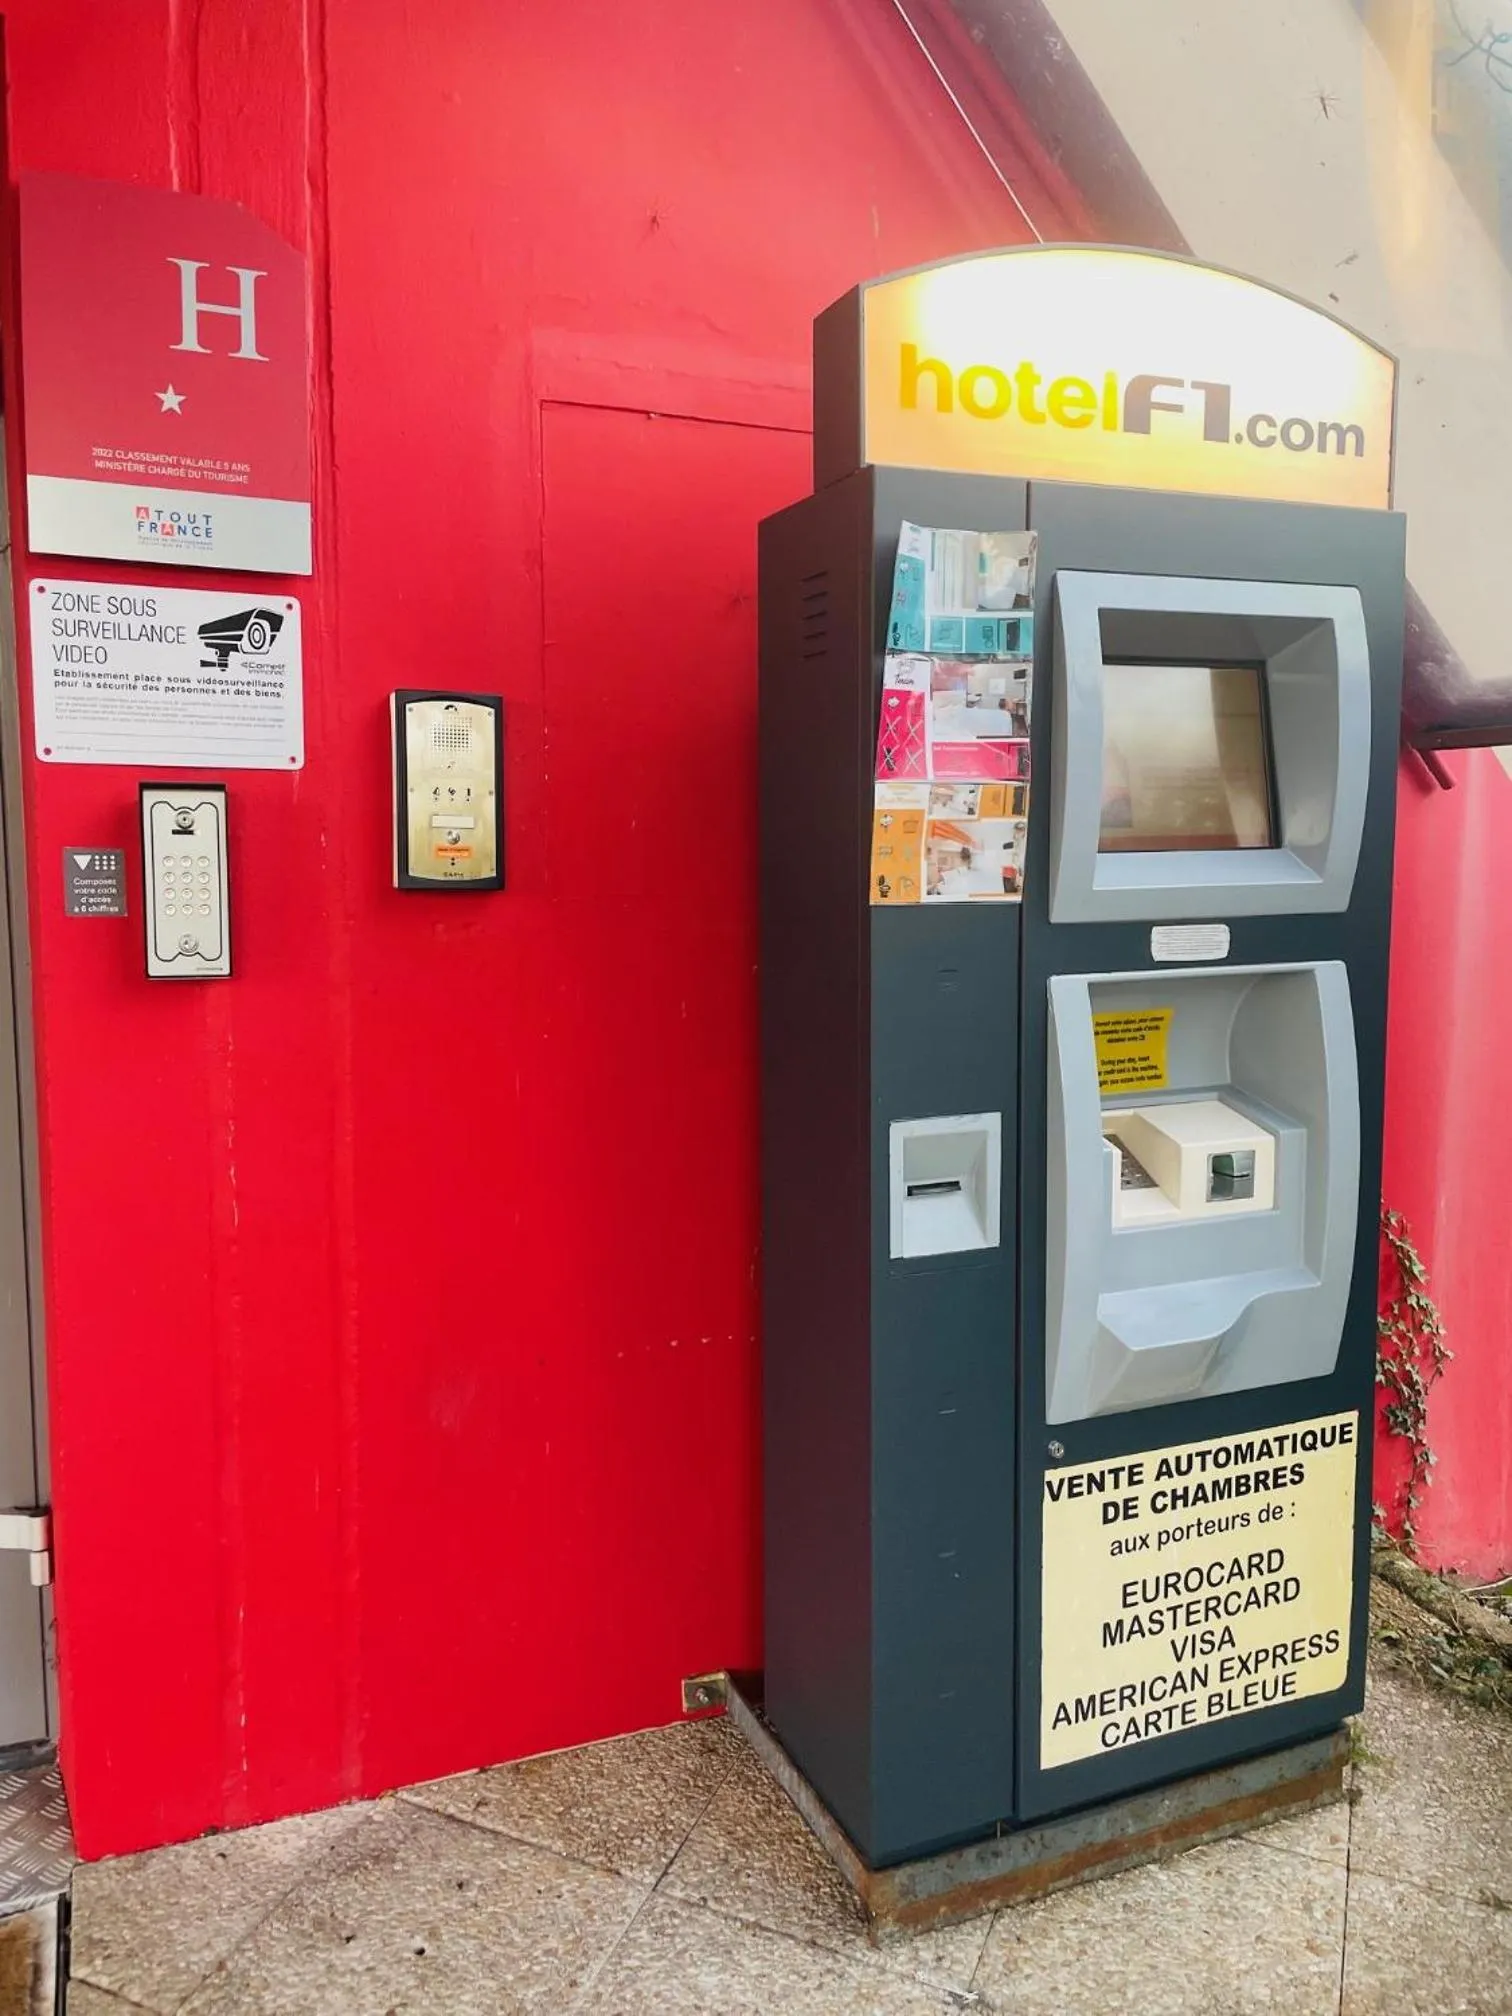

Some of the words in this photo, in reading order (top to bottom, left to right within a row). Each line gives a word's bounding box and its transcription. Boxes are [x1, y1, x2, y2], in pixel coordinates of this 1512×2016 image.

[165, 257, 270, 362] H
[92, 447, 113, 458] 2022
[115, 449, 177, 464] CLASSEMENT
[180, 456, 222, 470] VALABLE
[231, 463, 251, 473] ANS
[188, 468, 201, 479] DU
[203, 471, 249, 484] TOURISME
[137, 520, 213, 538] FRANCE
[51, 592, 101, 614] ZONE
[107, 596, 157, 617] SOUS
[52, 618, 187, 644] SURVEILLANCE
[52, 644, 107, 664] VIDEO
[54, 680, 78, 688] pour
[164, 685, 217, 694] personnes
[233, 687, 252, 696] des
[1045, 1462, 1145, 1503] VENTE
[1154, 1421, 1354, 1481] AUTOMATIQUE
[1102, 1496, 1139, 1525] DE
[1150, 1462, 1305, 1515] CHAMBRES
[1109, 1530, 1150, 1557] aux
[1157, 1511, 1251, 1552] porteurs
[1257, 1502, 1284, 1522] de
[1121, 1548, 1285, 1609] EUROCARD
[1102, 1576, 1301, 1649] MASTERCARD
[1170, 1625, 1236, 1663] VISA
[1052, 1662, 1210, 1731] AMERICAN
[1219, 1629, 1340, 1683] EXPRESS
[1100, 1699, 1197, 1748] CARTE
[1207, 1671, 1298, 1718] BLEUE
